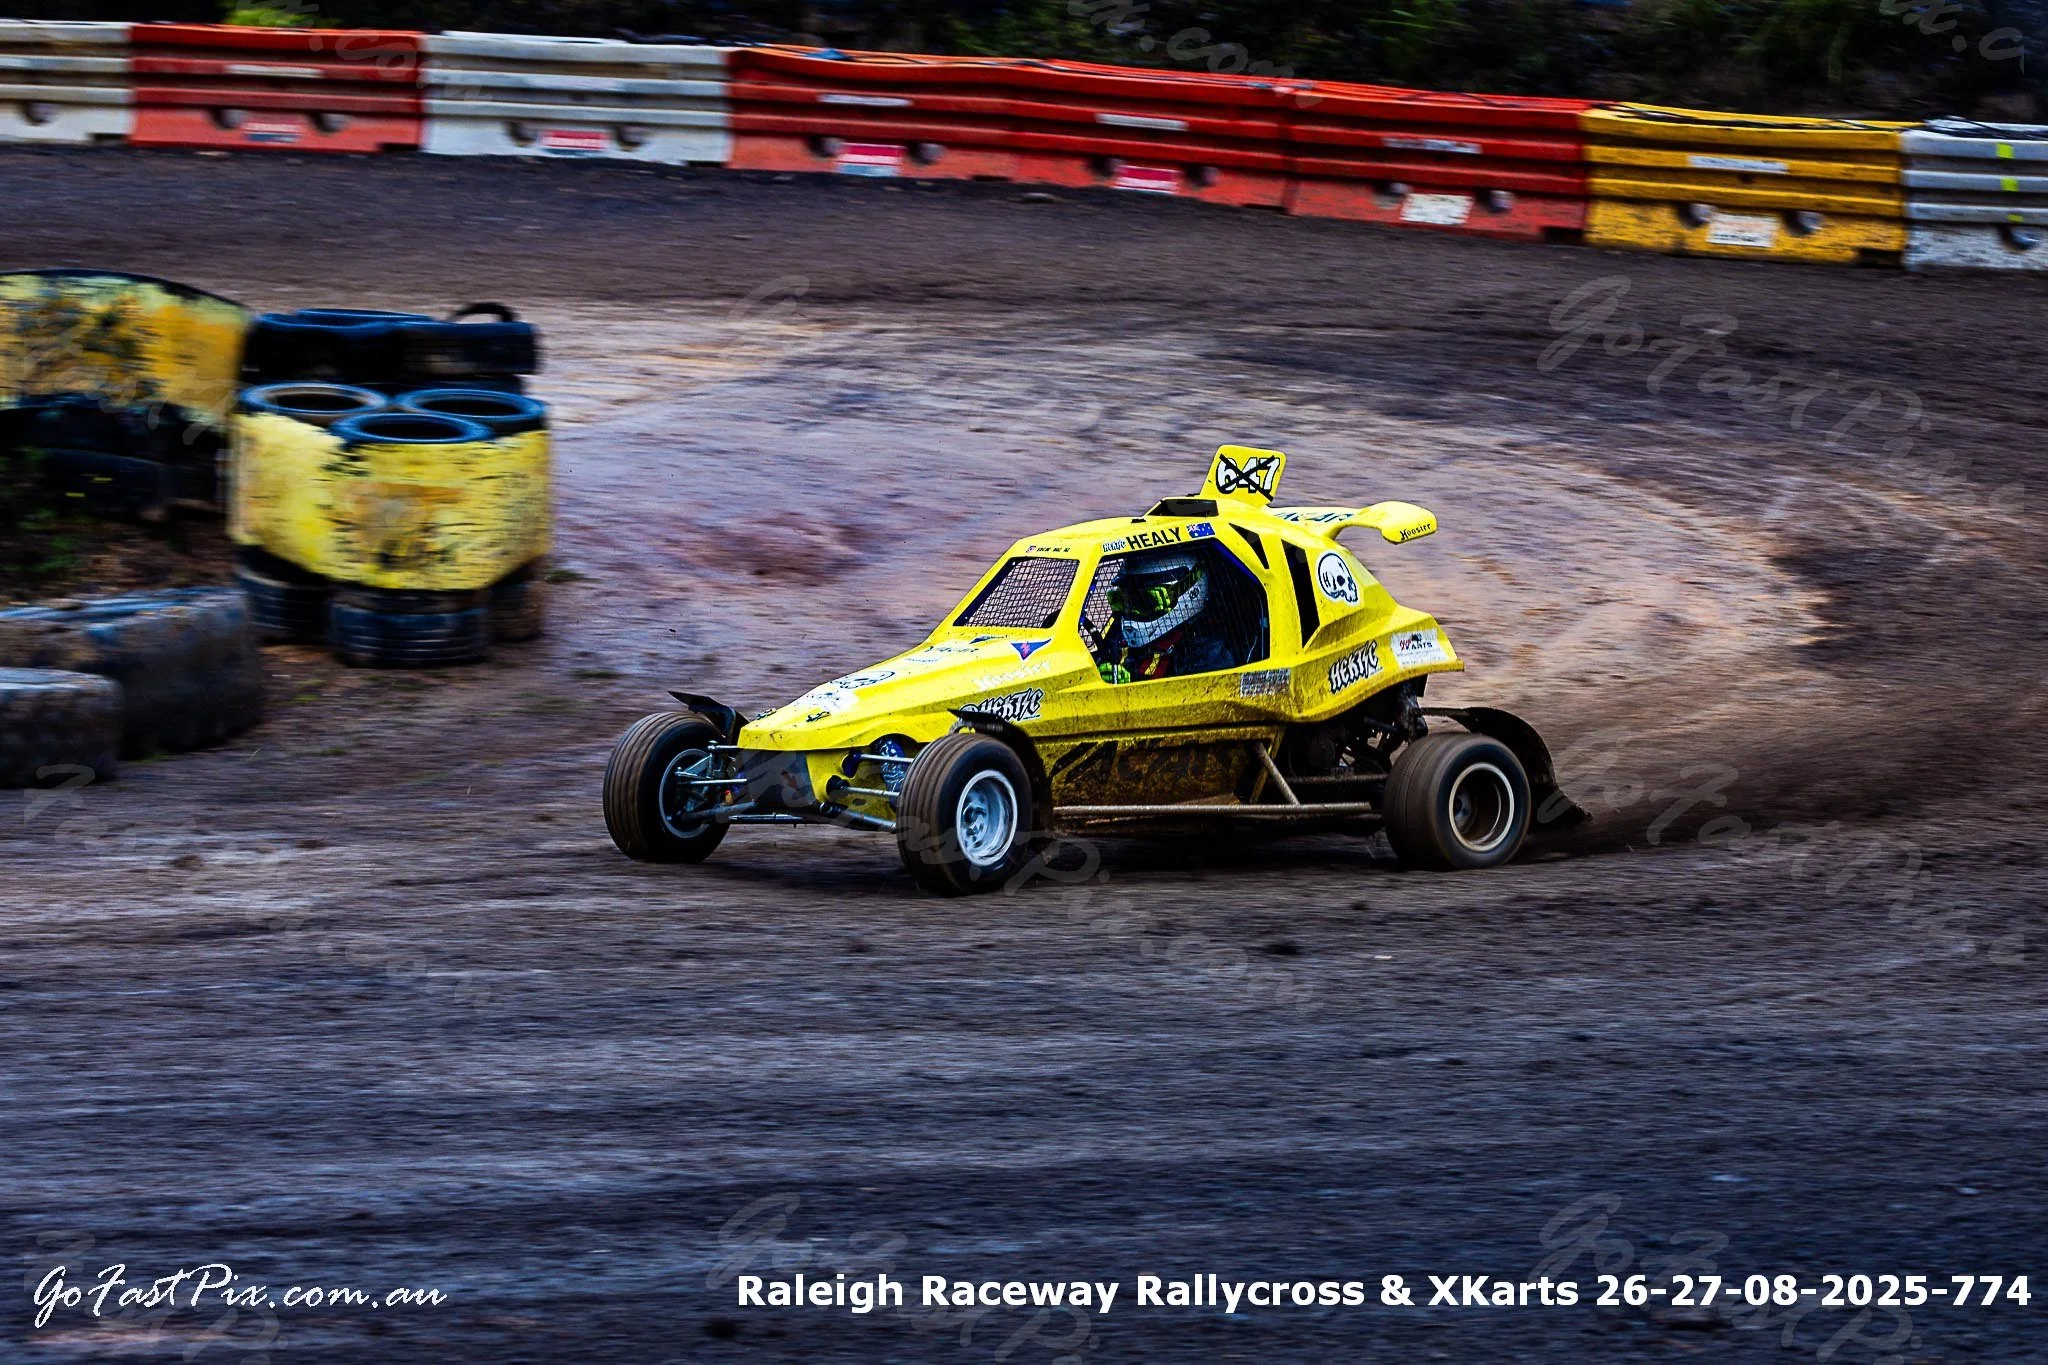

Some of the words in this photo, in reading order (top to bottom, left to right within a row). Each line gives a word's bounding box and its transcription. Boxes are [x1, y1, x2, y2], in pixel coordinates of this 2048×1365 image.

[1216, 456, 1281, 494] 647
[1126, 526, 1182, 550] HEALY
[1400, 522, 1432, 541] Hoosier
